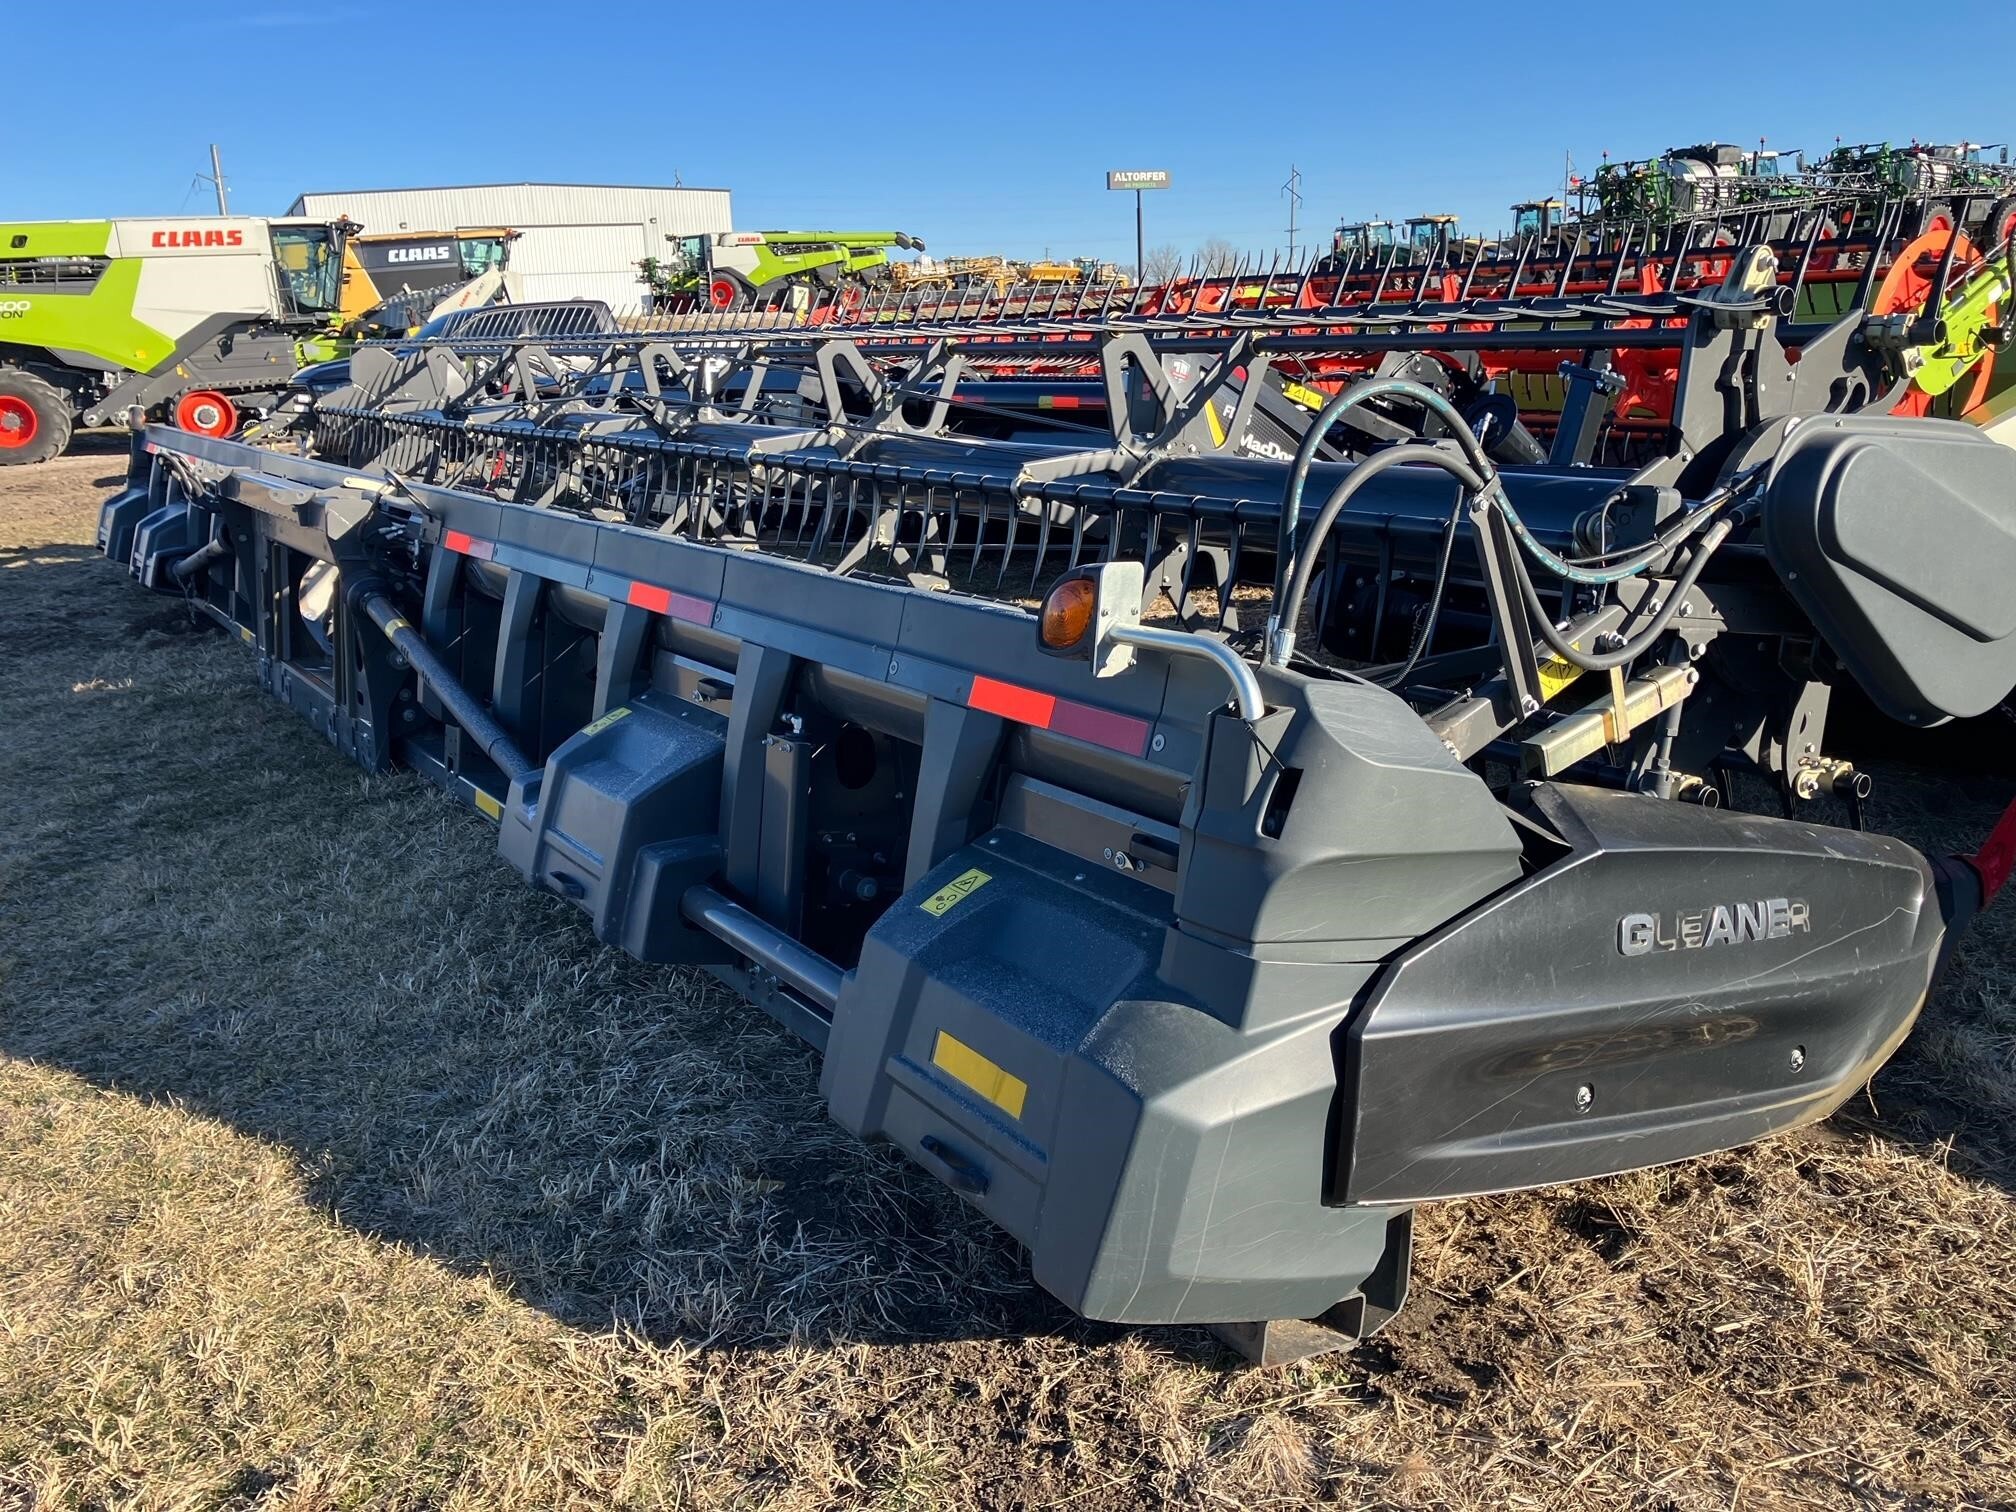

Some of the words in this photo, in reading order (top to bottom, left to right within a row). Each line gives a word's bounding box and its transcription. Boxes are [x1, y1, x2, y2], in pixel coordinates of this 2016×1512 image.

[1114, 171, 1167, 182] ALTORFER
[151, 229, 243, 248] CLAAS
[387, 246, 450, 263] CLAAS
[0, 300, 31, 311] 00
[1616, 898, 1811, 957] GLEANER
